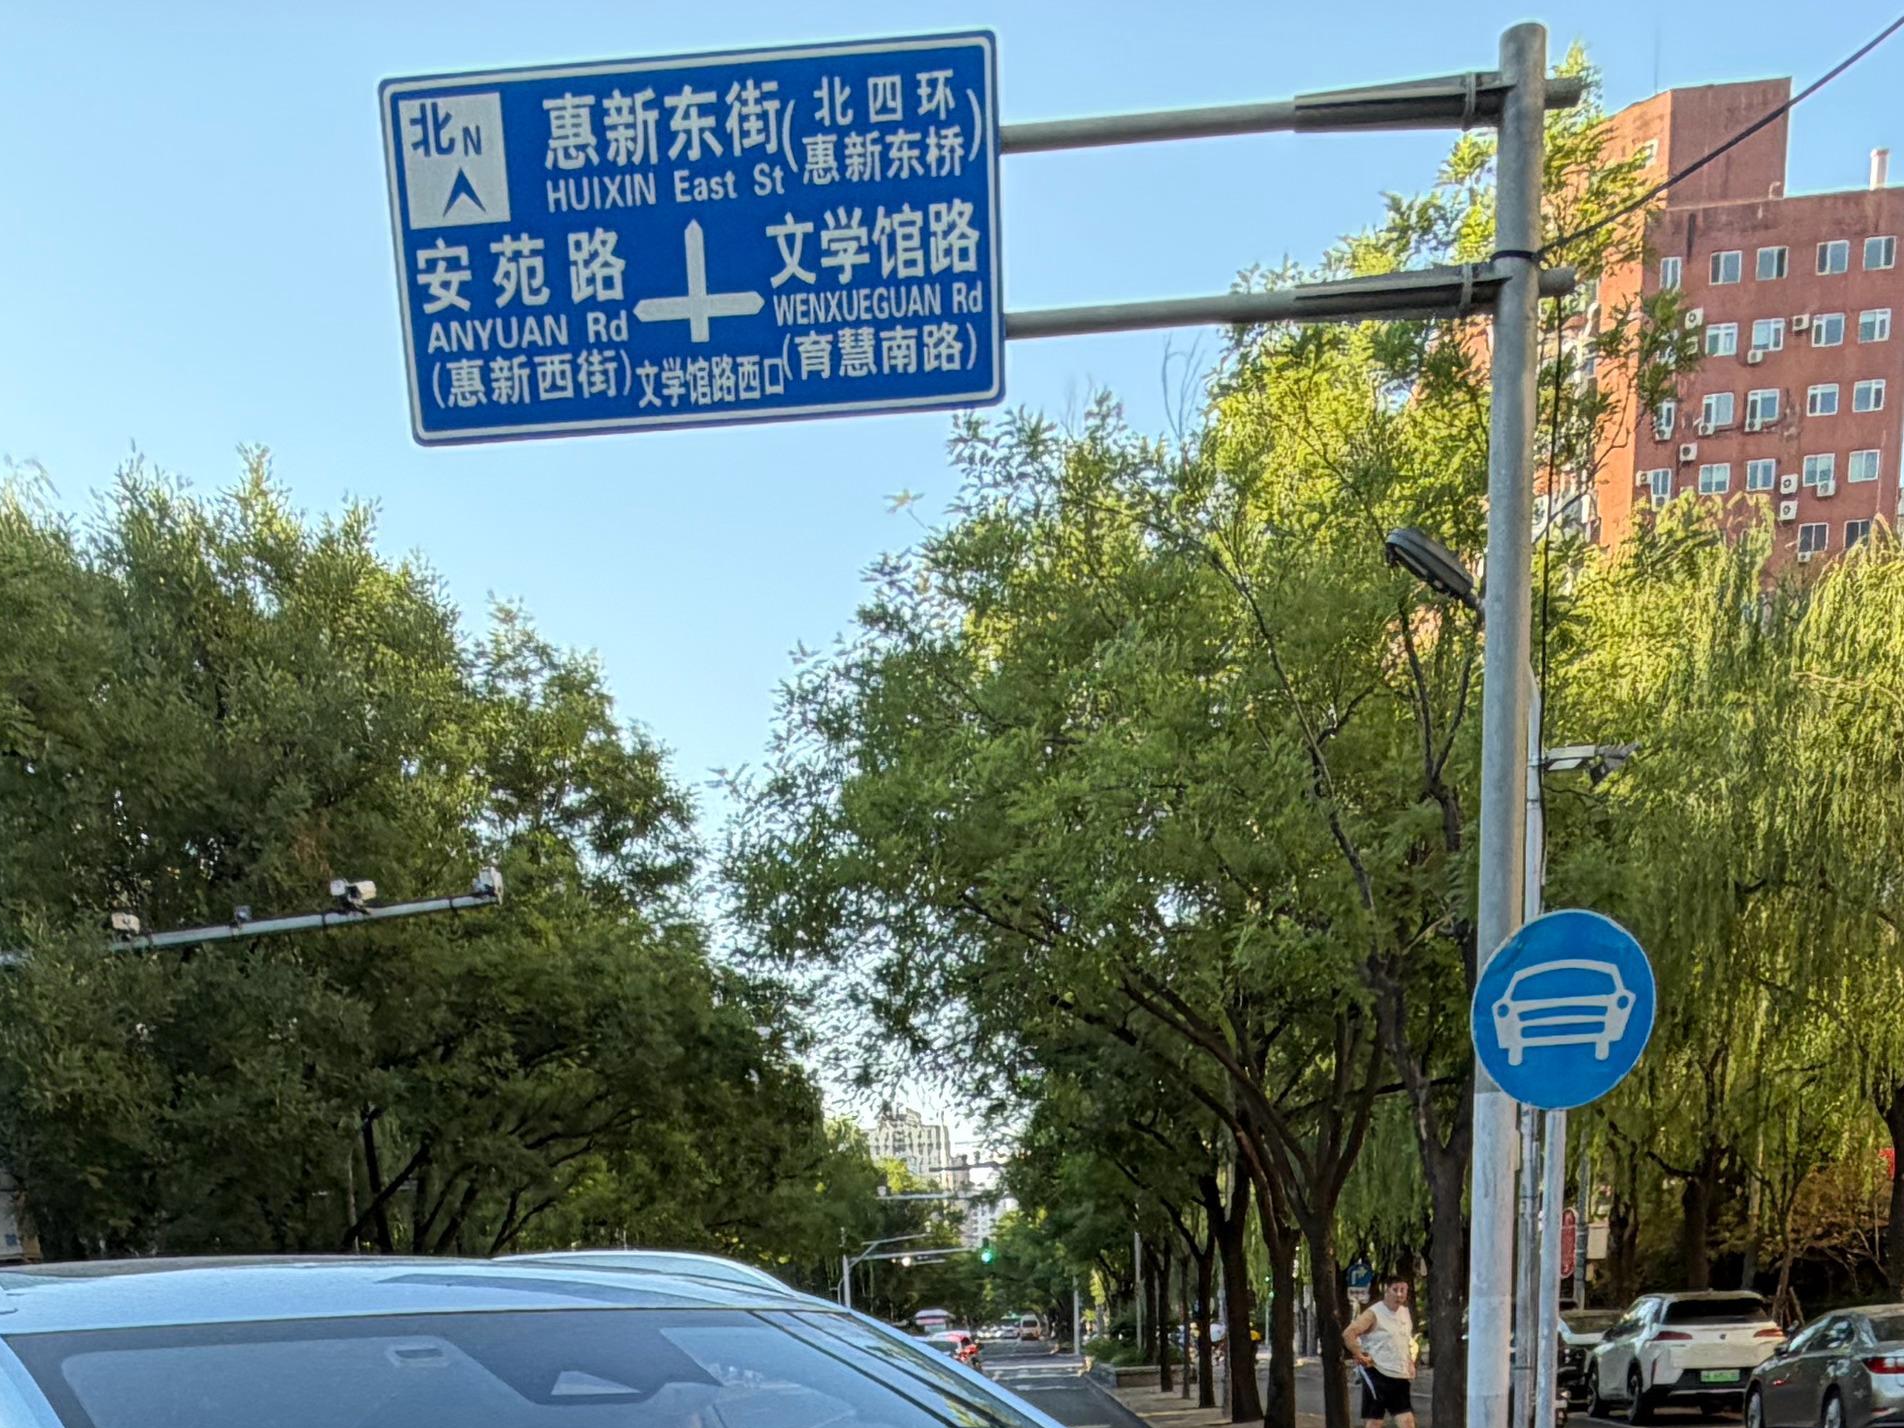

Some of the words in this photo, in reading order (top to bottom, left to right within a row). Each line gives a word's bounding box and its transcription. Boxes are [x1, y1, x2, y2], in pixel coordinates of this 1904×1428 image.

[542, 79, 781, 170] 惠新东街
[814, 69, 955, 126] 北四环
[802, 125, 964, 185] 惠新东桥
[547, 173, 656, 213] HUIXIN
[675, 170, 736, 202] East
[753, 163, 785, 196] St
[416, 227, 627, 314] 安苑路
[766, 198, 981, 288] 文学馆路
[427, 316, 568, 353] ANYUAN
[587, 310, 628, 343] Rd
[773, 285, 941, 326] WENXUEGUAN
[952, 282, 983, 313] Rd
[636, 354, 785, 408] 文学馆路西口
